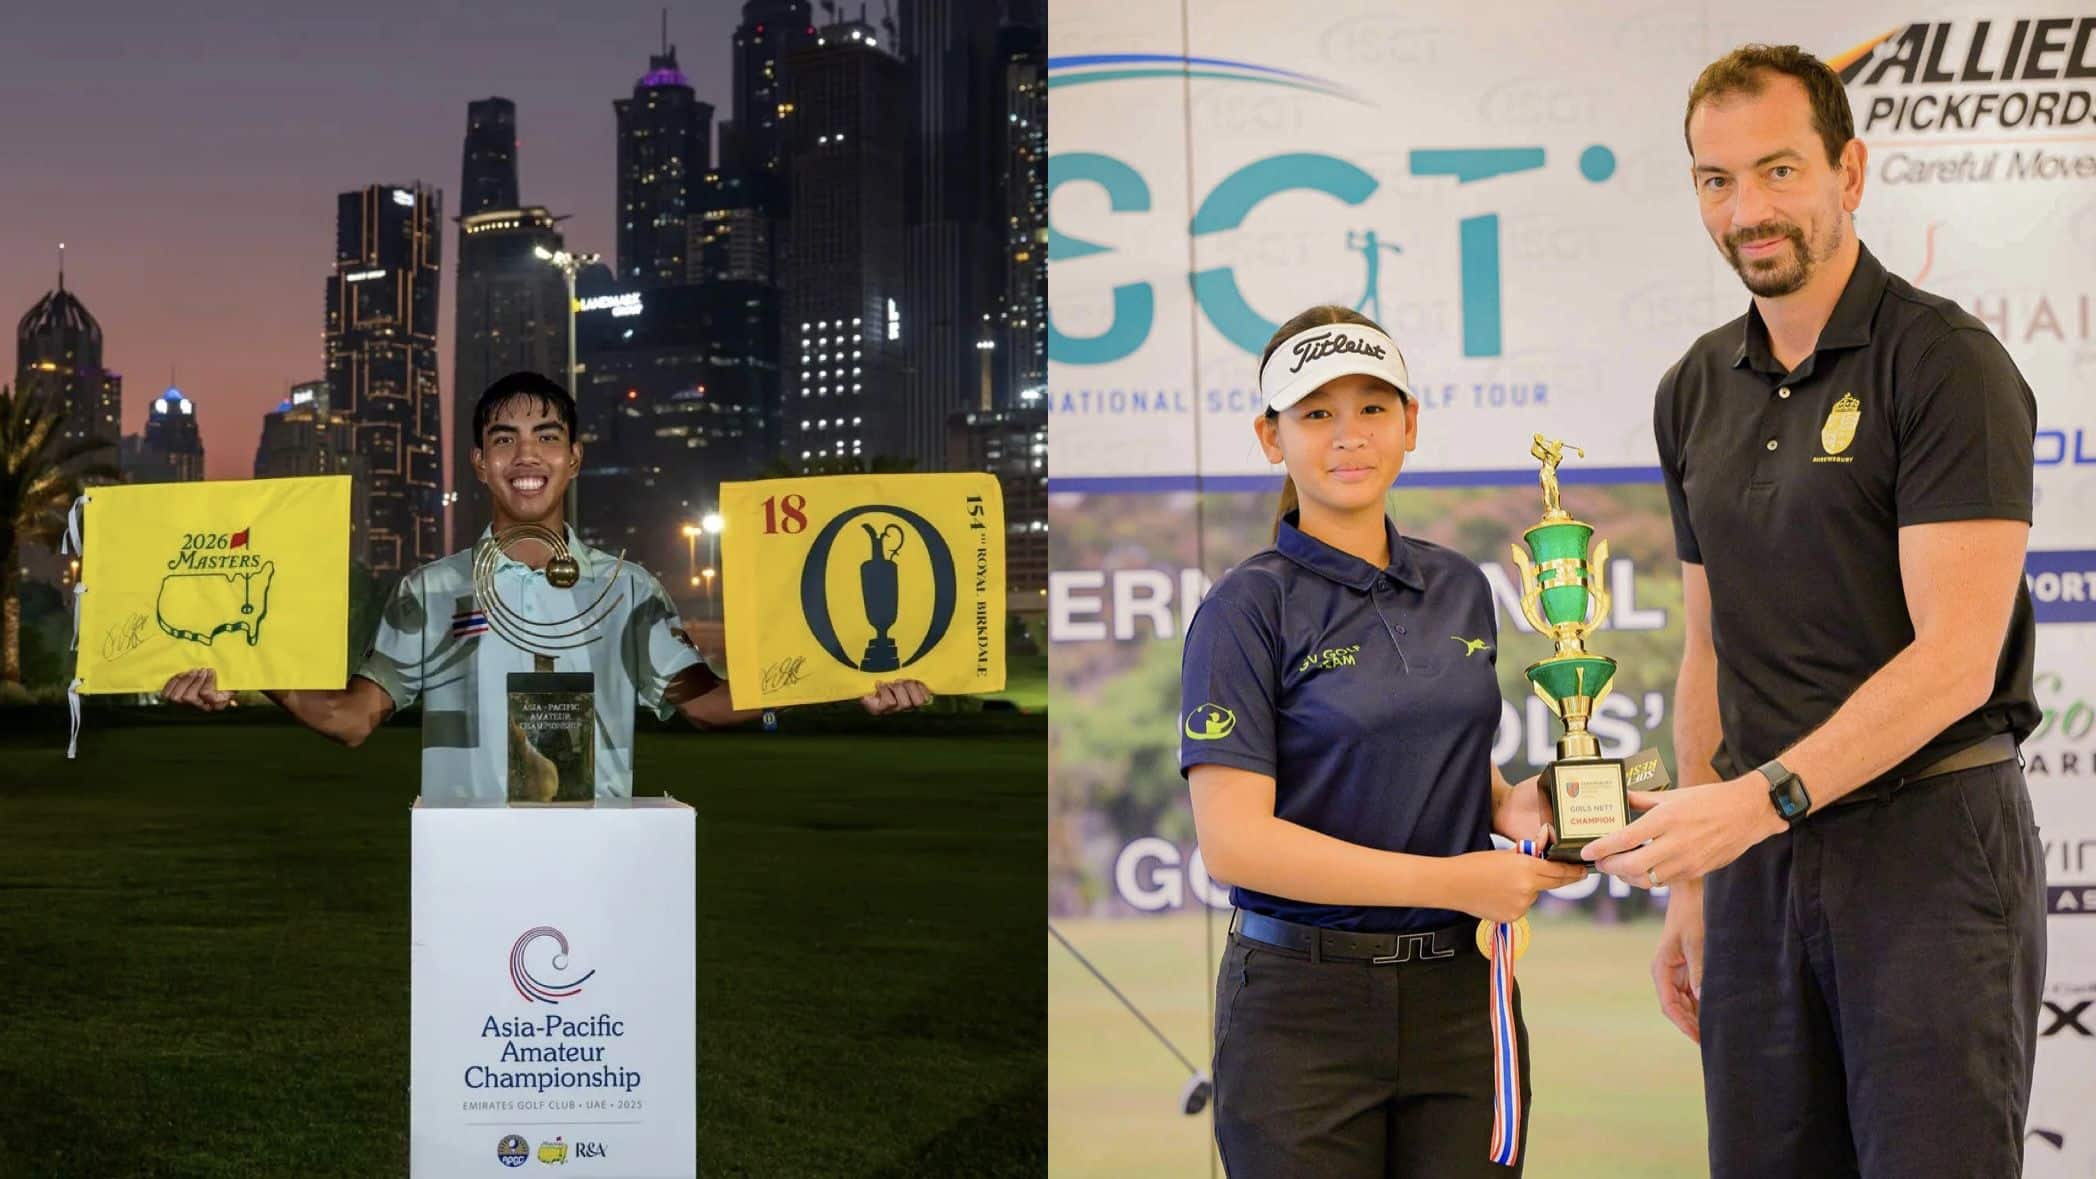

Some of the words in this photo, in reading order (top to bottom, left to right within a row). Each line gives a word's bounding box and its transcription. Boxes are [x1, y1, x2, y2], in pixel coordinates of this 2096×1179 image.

[1880, 150, 1998, 185] Careful
[1289, 331, 1387, 374] Titleist
[1472, 383, 1549, 407] TOUR
[760, 493, 808, 535] 18
[182, 533, 228, 551] 2026
[975, 548, 988, 597] ROYAL
[975, 601, 989, 678] BIRKDALE
[2029, 752, 2096, 775] AR
[1570, 816, 1616, 825] CHAMPION
[481, 1014, 625, 1038] Asia-Pacific
[500, 1040, 606, 1063] Amateur
[464, 1065, 641, 1093] Championship
[463, 1101, 514, 1111] EMIRATES
[517, 1101, 546, 1111] GOLF
[548, 1100, 576, 1110] CLUB
[586, 1100, 607, 1110] UAE
[617, 1100, 643, 1109] 2025
[575, 1141, 607, 1158] R&A
